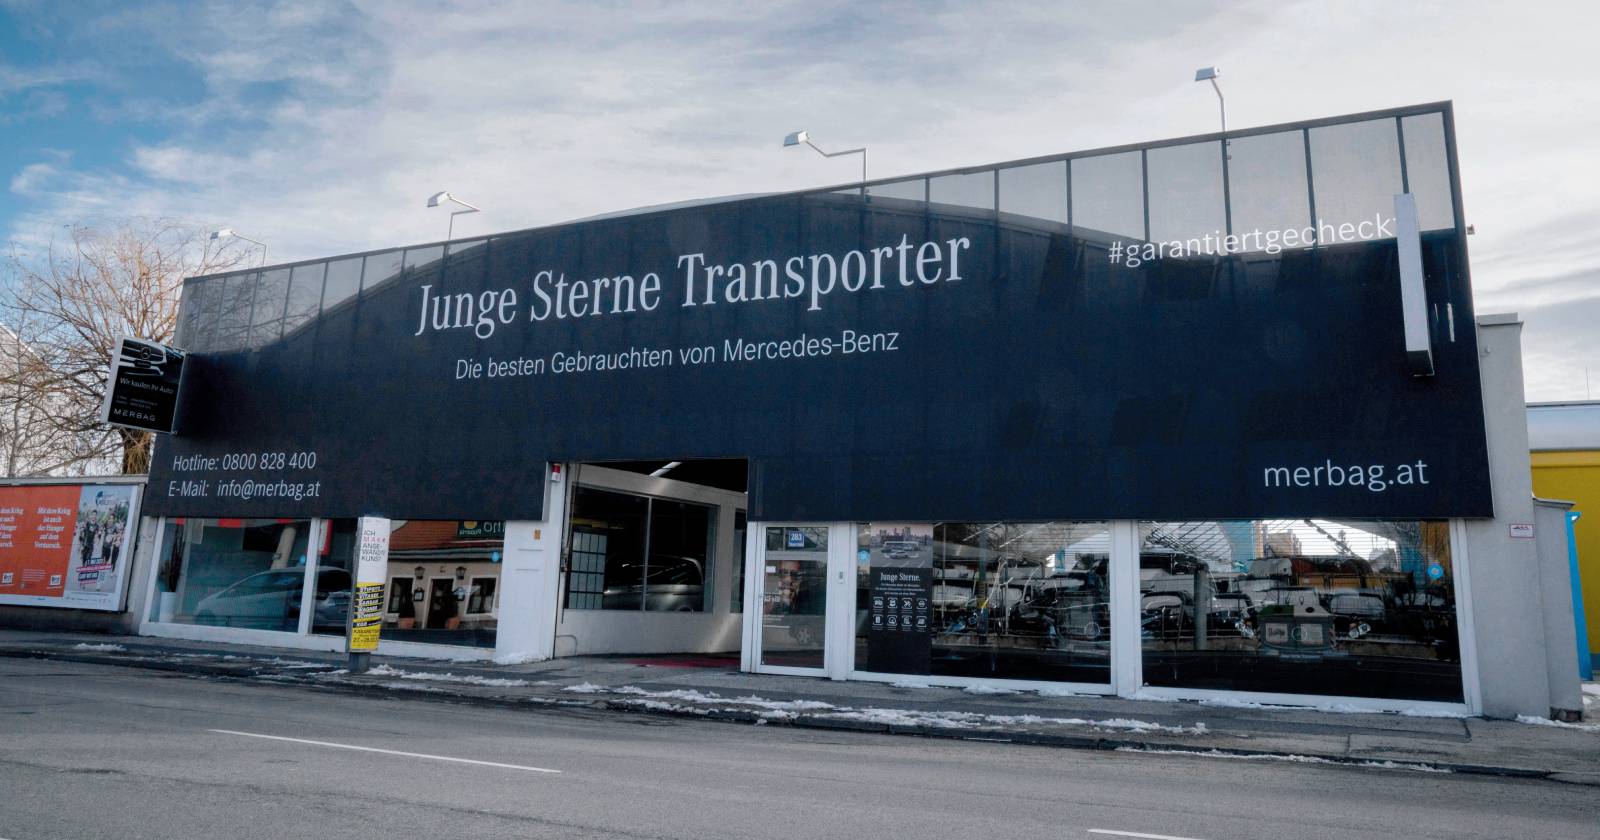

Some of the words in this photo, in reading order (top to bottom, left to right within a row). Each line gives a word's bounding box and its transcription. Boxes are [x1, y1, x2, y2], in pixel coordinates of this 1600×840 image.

[1108, 213, 1398, 268] #garantiertgecheck
[415, 283, 517, 339] Junge
[530, 269, 661, 322] Sterne
[677, 232, 971, 311] Transporter
[455, 357, 482, 380] Die
[488, 354, 545, 378] besten
[551, 346, 673, 374] Gebrauchten
[680, 343, 716, 366] von
[723, 329, 899, 362] Mercedes-Benz
[114, 408, 156, 421] MERBAG
[173, 454, 219, 471] Hotline:
[222, 453, 257, 470] 0800
[260, 452, 286, 470] 828
[289, 452, 317, 469] 400
[1264, 459, 1430, 492] merbag.at
[168, 480, 210, 497] E-Mail:
[217, 479, 321, 501] info@merbag.at
[790, 533, 802, 541] 283
[880, 572, 898, 582] Junge
